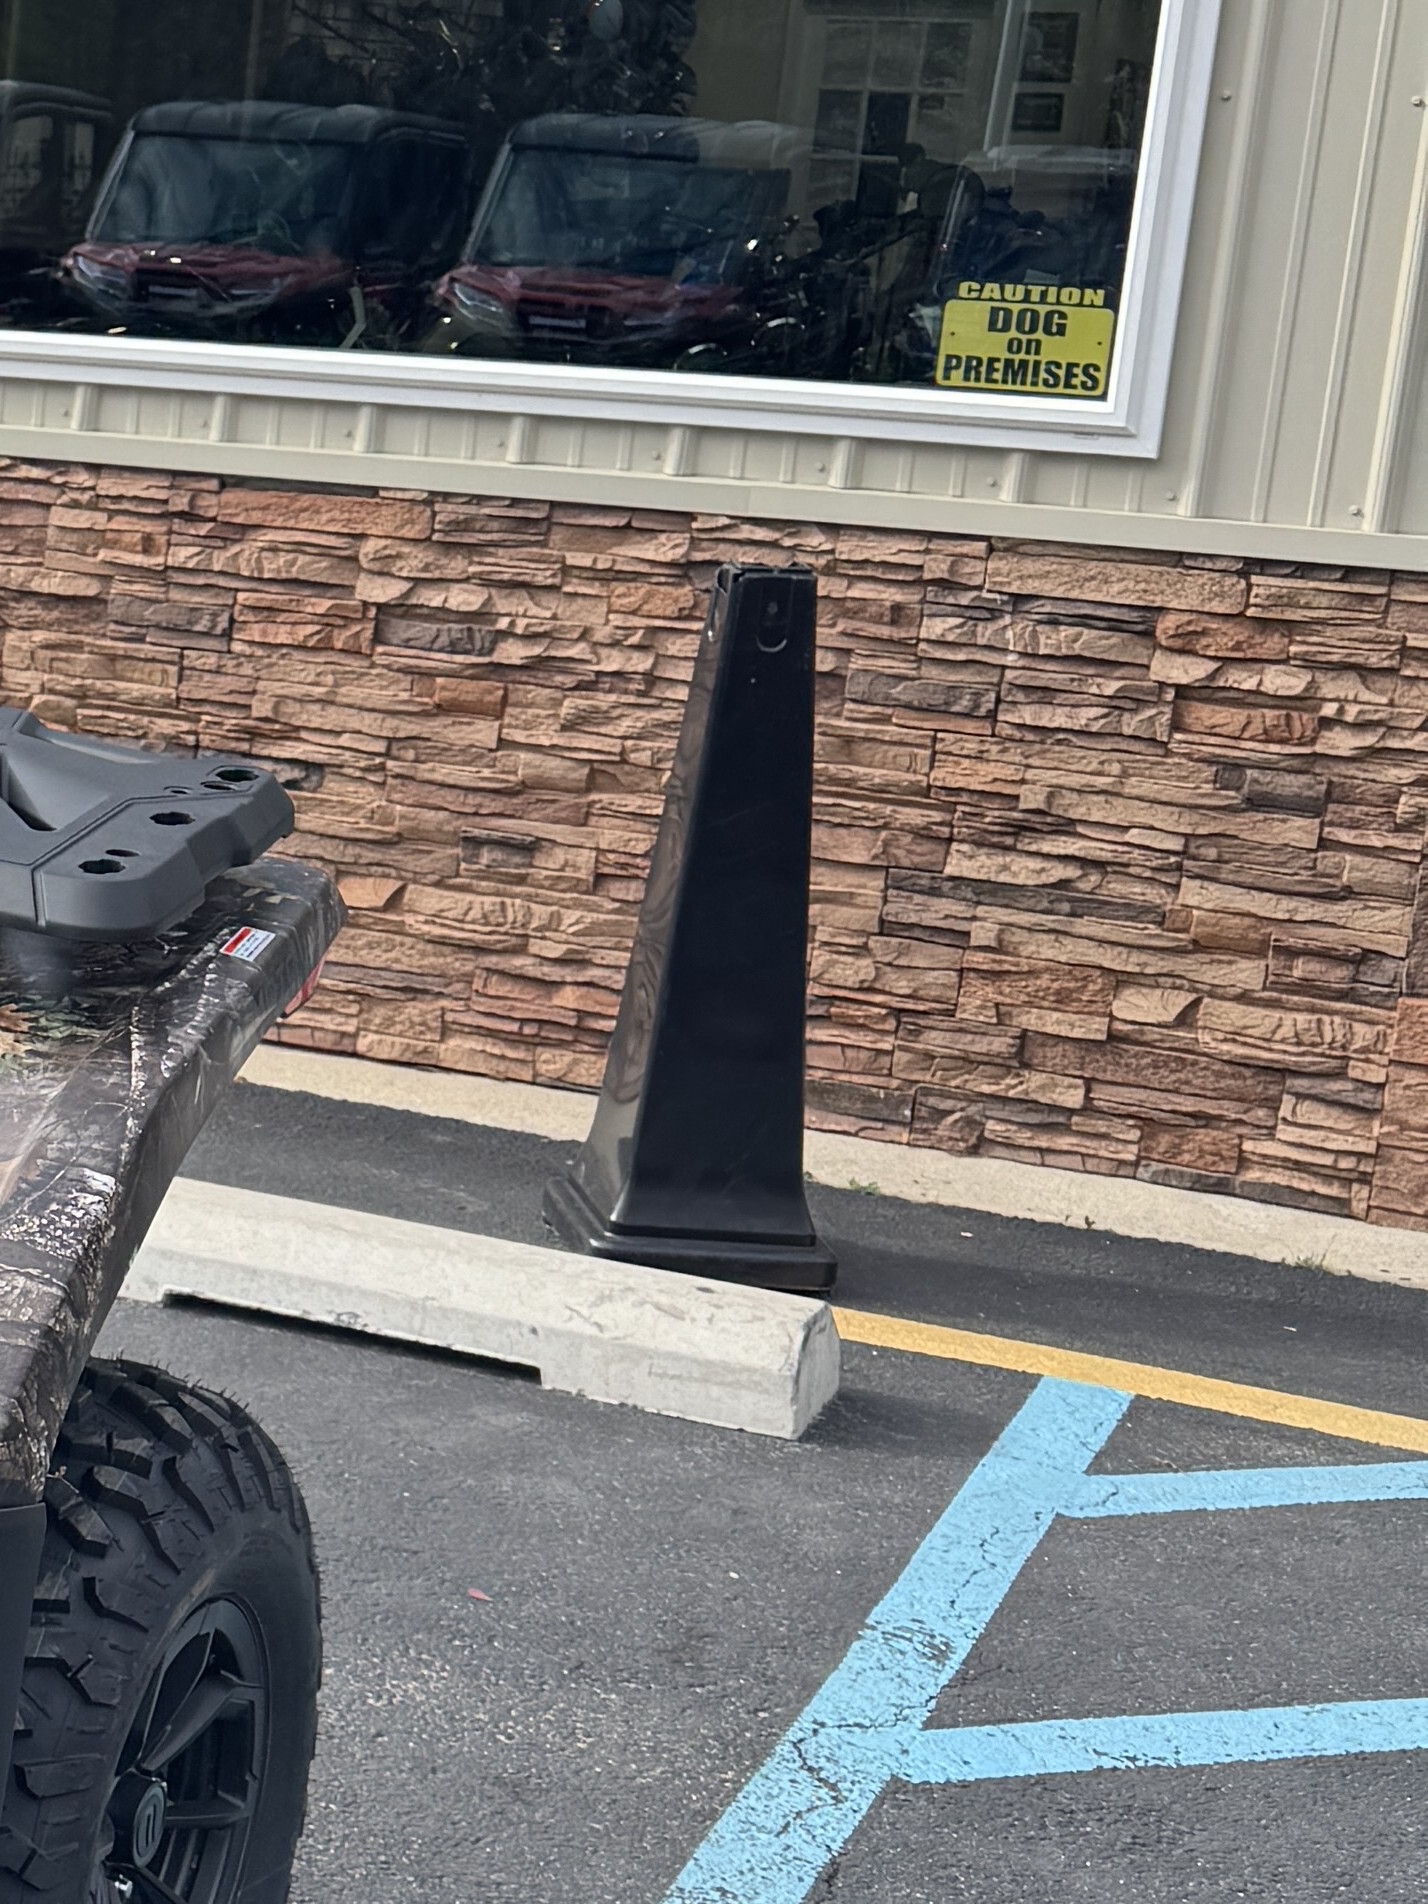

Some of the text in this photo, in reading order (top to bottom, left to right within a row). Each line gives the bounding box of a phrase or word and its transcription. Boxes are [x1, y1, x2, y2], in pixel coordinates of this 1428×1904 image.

[958, 281, 1105, 306] CAUTION
[987, 306, 1068, 337] DOG
[1007, 337, 1042, 356] on
[943, 354, 1101, 391] PREMISES
